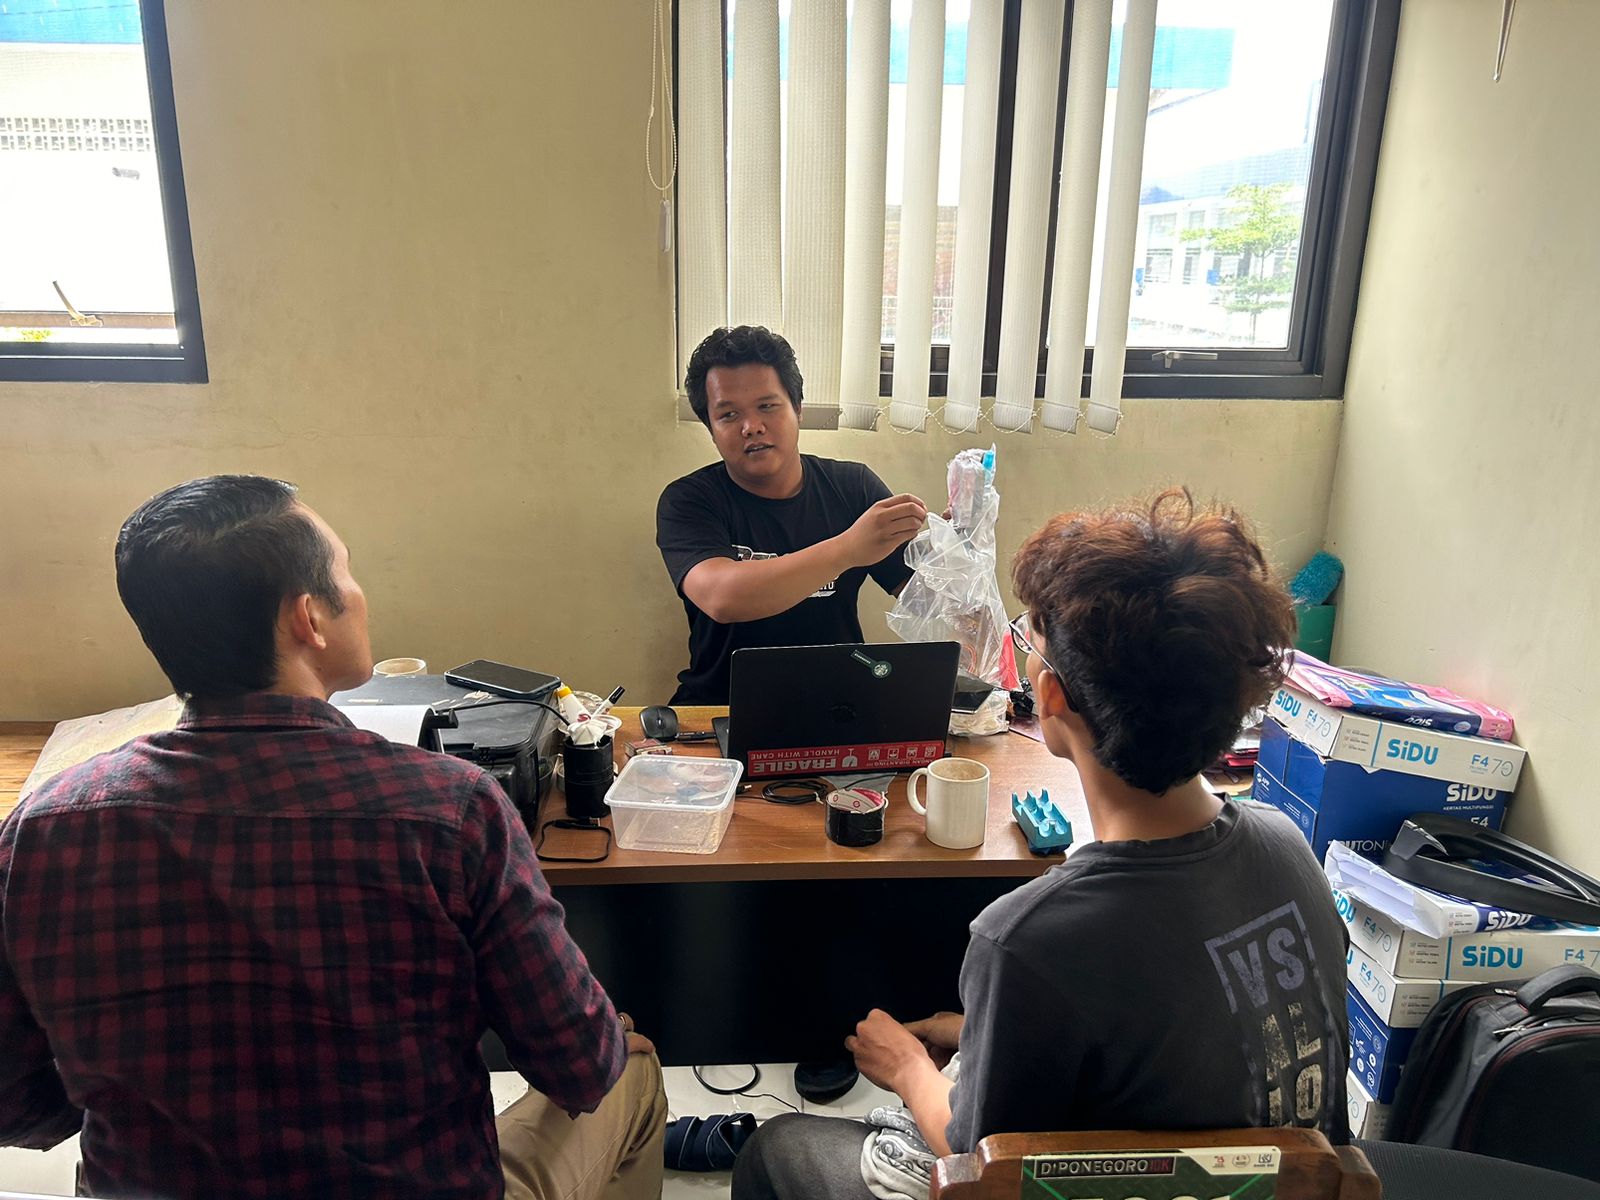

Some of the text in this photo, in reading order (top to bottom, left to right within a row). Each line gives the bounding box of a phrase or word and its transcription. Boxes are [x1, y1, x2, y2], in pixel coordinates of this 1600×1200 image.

[1275, 690, 1302, 717] SiDU
[1307, 709, 1318, 723] F4
[777, 751, 801, 759] WITH
[803, 749, 840, 757] HANDLE
[1386, 739, 1439, 766] SiDU
[1471, 754, 1489, 767] F4
[753, 758, 837, 773] FRAGILE
[1364, 916, 1377, 934] F4
[1461, 945, 1523, 969] SiDU
[1564, 948, 1585, 962] F4
[1227, 927, 1305, 1009] VS
[1361, 962, 1373, 981] F4
